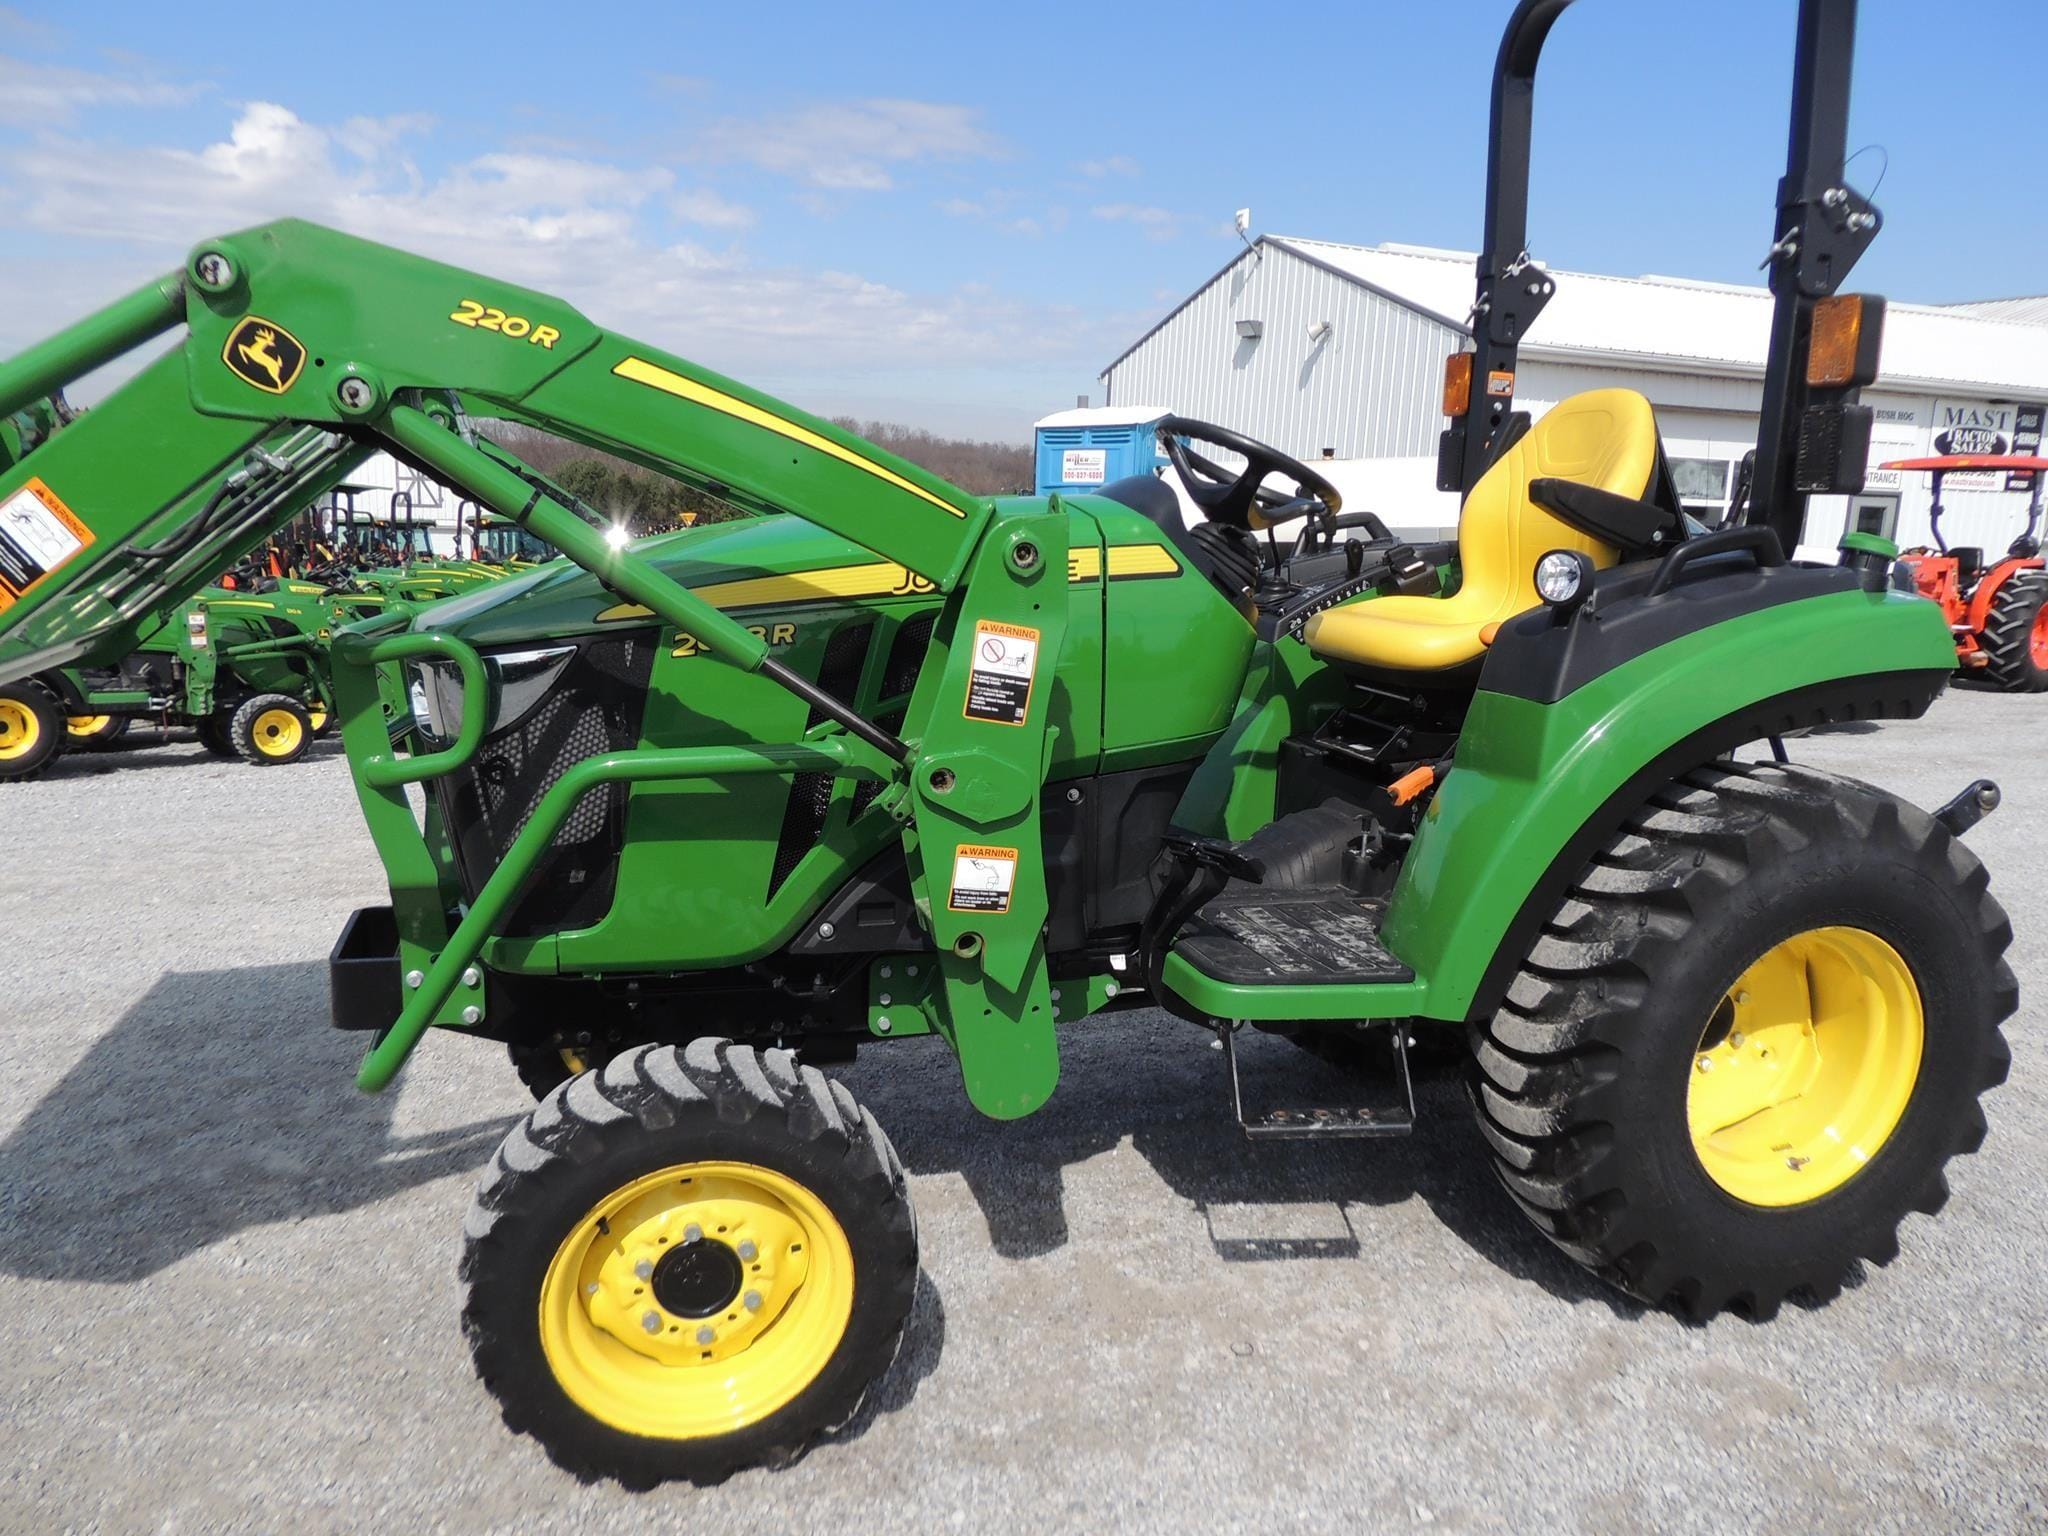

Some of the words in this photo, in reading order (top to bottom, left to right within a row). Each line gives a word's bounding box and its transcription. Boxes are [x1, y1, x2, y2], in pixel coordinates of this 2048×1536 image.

[1898, 411, 1915, 421] HOG
[1943, 407, 2011, 430] MAST
[1946, 429, 1998, 443] TRACTOR
[1950, 441, 1993, 454] SALES
[990, 623, 1036, 640] WARNING
[969, 847, 1014, 859] WARNING
